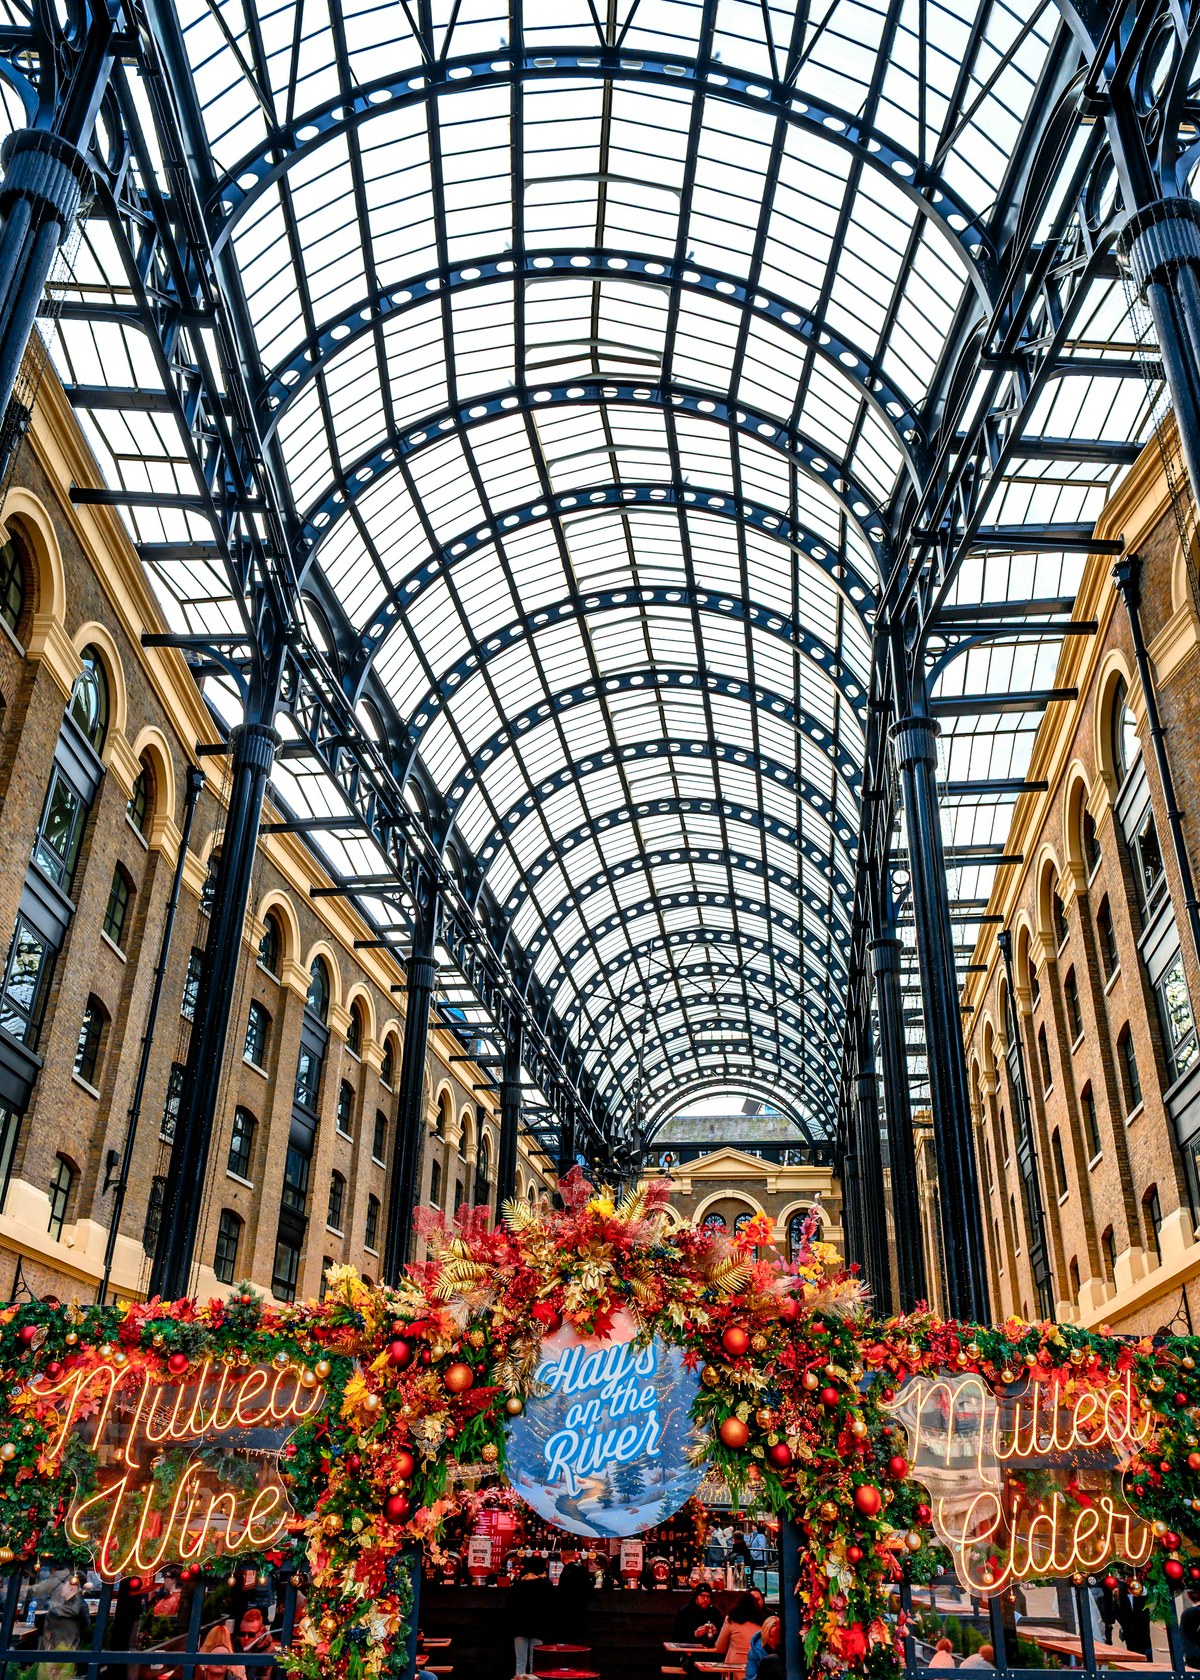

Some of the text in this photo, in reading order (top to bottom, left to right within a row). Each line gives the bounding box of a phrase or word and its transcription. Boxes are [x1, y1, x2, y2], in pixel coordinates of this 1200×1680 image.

[31, 1360, 323, 1468] Mulled
[544, 1409, 661, 1497] River
[565, 1376, 657, 1429] on the
[878, 1369, 1152, 1485] Mulled
[72, 1461, 288, 1576] Wine
[939, 1492, 1147, 1590] Cider
